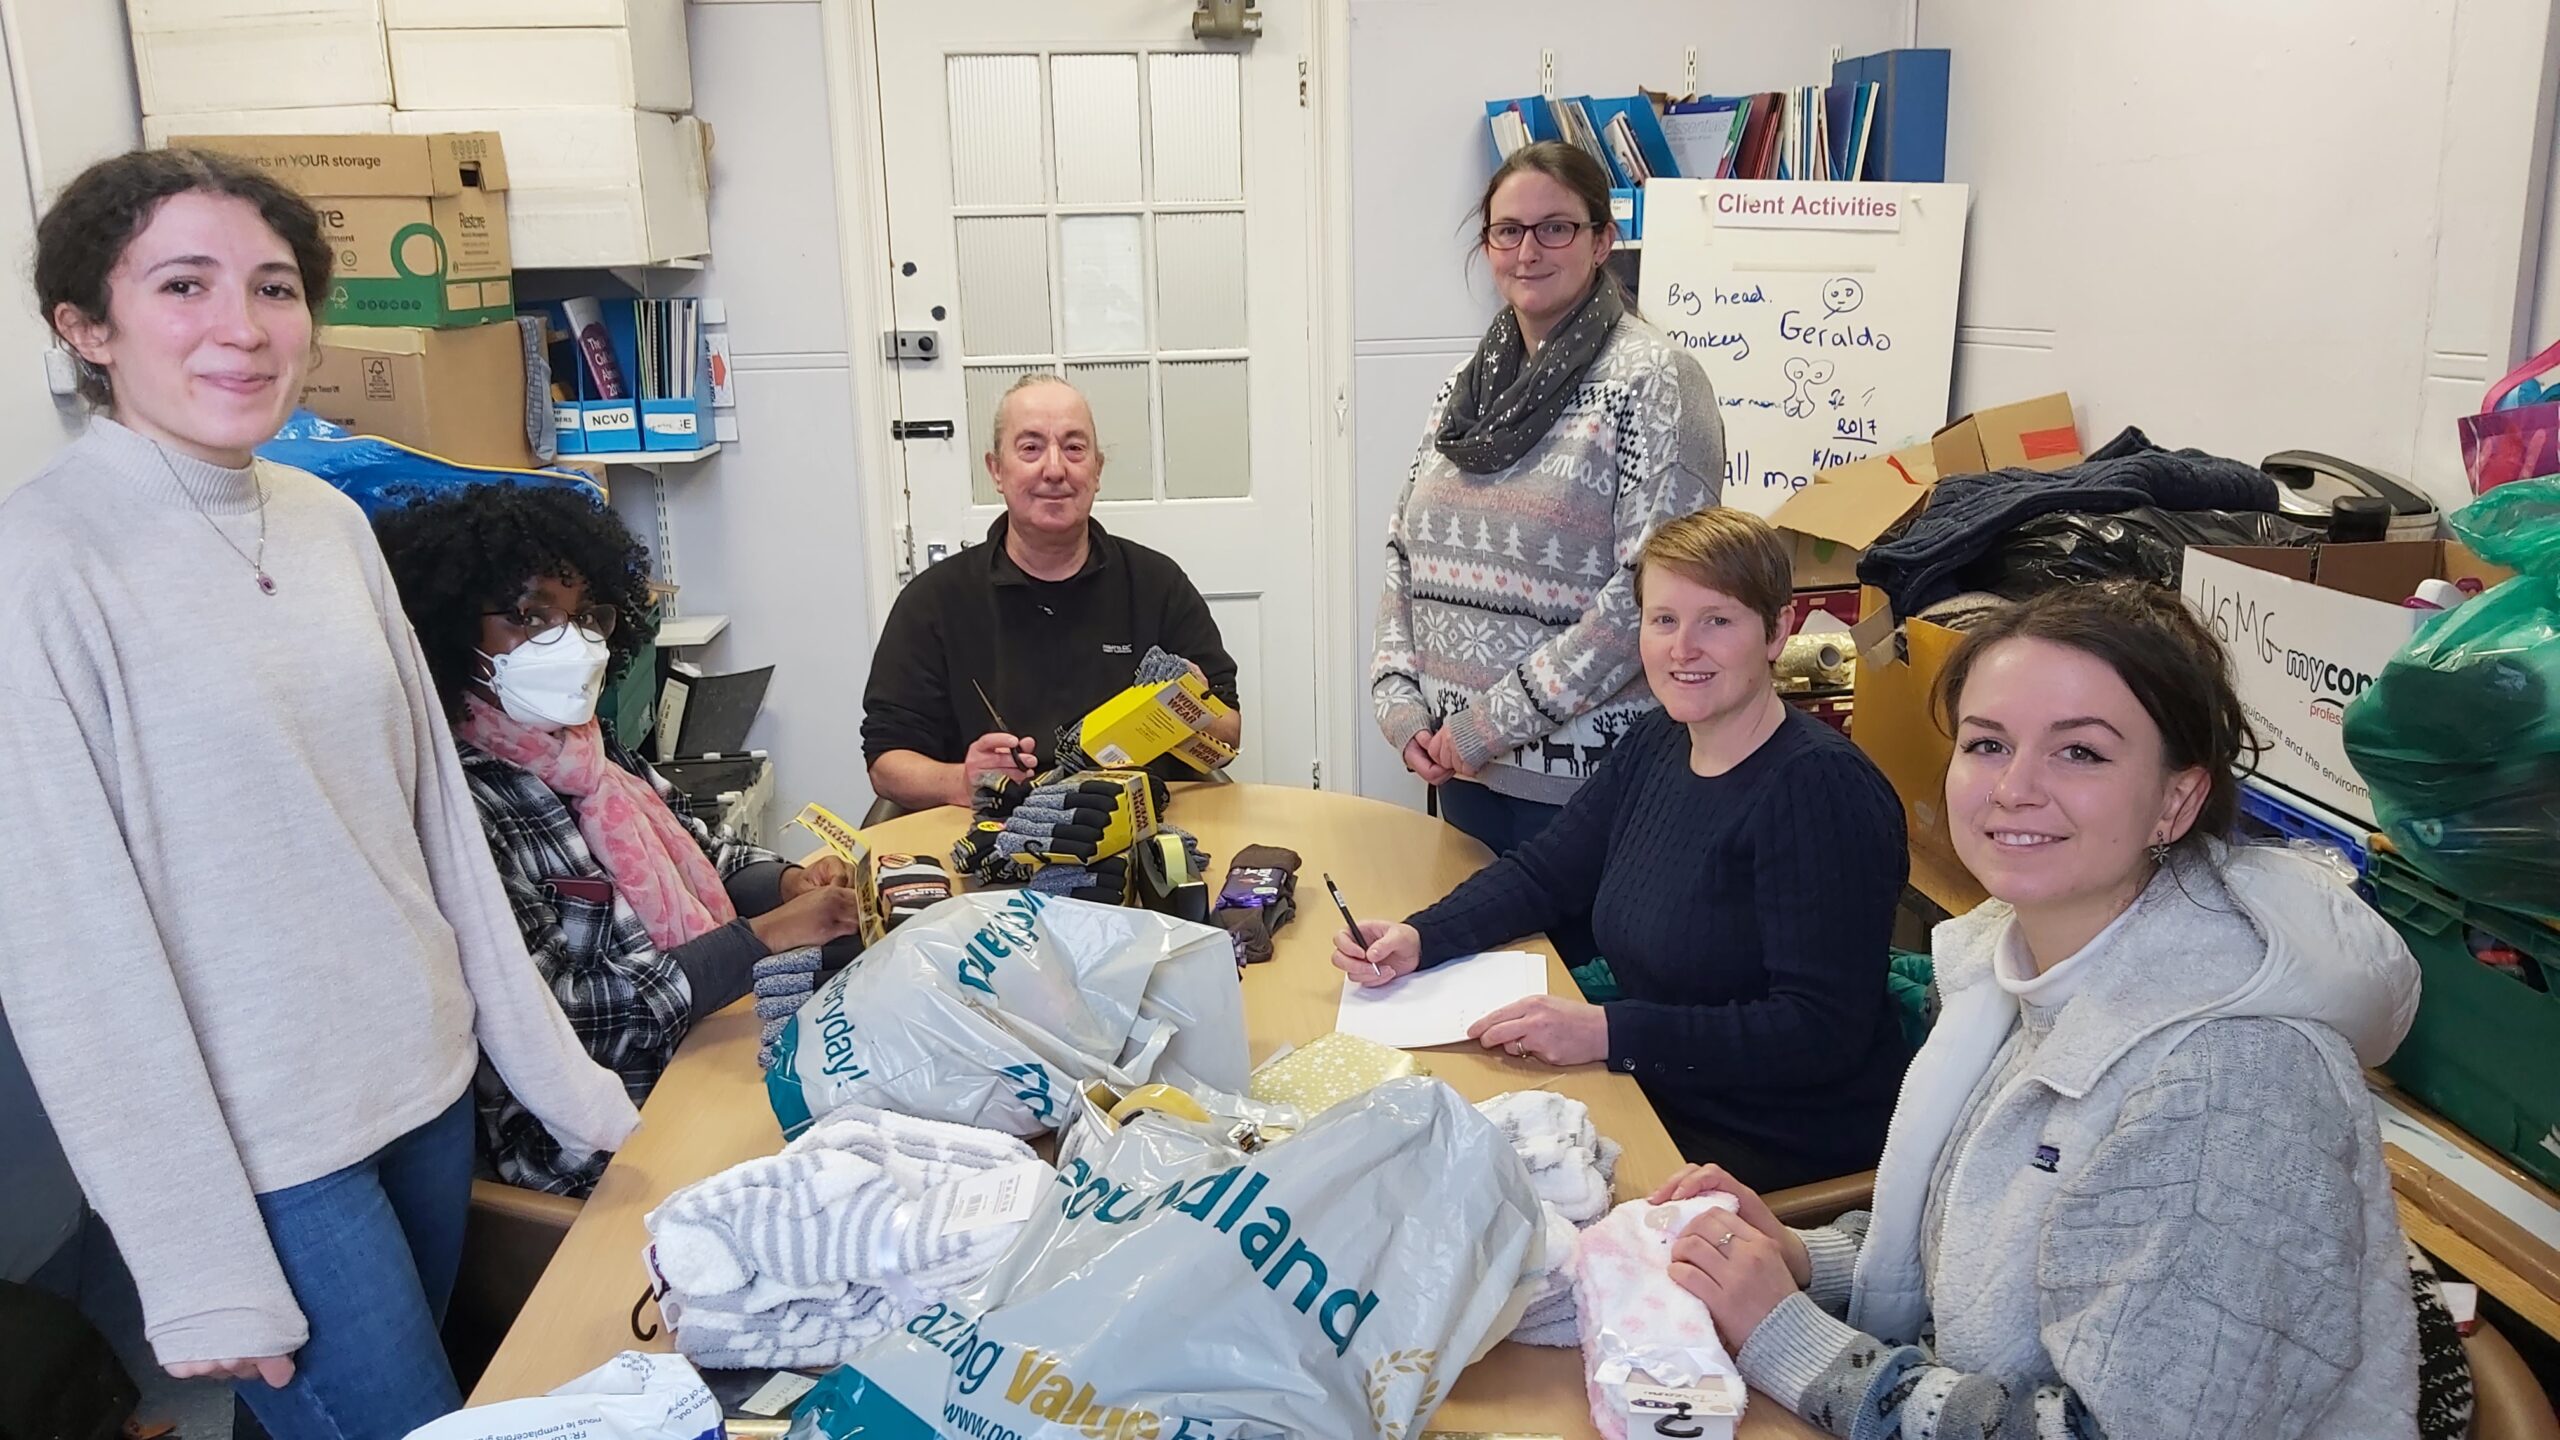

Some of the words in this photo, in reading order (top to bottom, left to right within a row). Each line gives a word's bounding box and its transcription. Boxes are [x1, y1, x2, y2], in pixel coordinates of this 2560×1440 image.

[275, 154, 288, 167] in
[289, 154, 330, 167] YOUR
[332, 154, 381, 170] storage
[1717, 192, 1785, 214] Client
[1791, 195, 1897, 217] Activities
[1667, 283, 1702, 316] Big
[1780, 309, 1891, 351] Geraldo
[592, 412, 630, 426] NCVO
[1167, 697, 1198, 725] WEAR
[1174, 691, 1206, 719] WORK
[2241, 701, 2283, 741] quipment
[2284, 735, 2303, 757] and
[2305, 750, 2321, 772] the
[1188, 745, 1217, 766] WEAR
[1194, 741, 1225, 761] WORK
[815, 959, 870, 1088] Everyday!
[906, 1302, 1004, 1395] azing
[577, 1416, 602, 1426] nous
